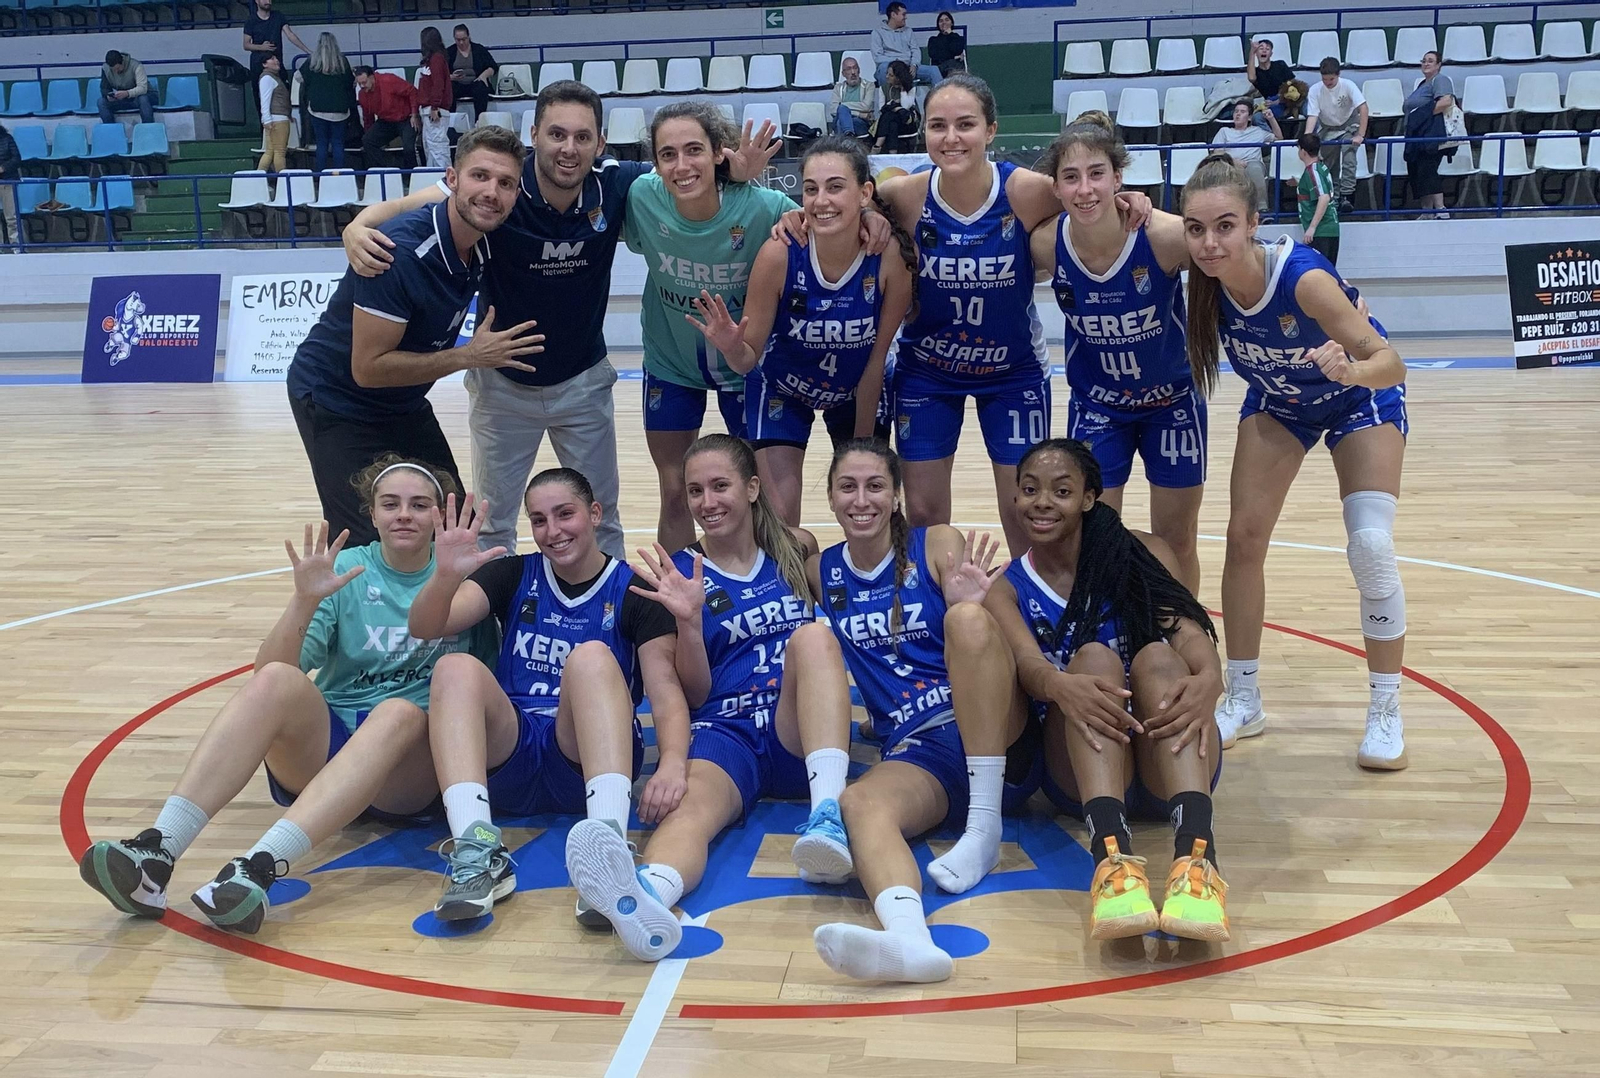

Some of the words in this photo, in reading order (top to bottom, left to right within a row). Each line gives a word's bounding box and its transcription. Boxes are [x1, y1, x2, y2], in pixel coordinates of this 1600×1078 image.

[529, 259, 589, 270] MundoMOVIL
[542, 267, 575, 276] Network
[657, 252, 748, 283] XEREZ
[919, 253, 1016, 283] XEREZ
[1537, 259, 1600, 289] DESAFIO
[674, 278, 697, 289] CLUB
[936, 281, 961, 289] CLUB
[962, 278, 1016, 290] DEPORTIVO
[1553, 290, 1593, 306] FITBOX
[949, 295, 984, 326] 10
[1064, 304, 1162, 336] XEREZ
[1516, 312, 1549, 323] TRABAJANDO
[1549, 312, 1555, 320] EL
[141, 314, 201, 333] XEREZ
[787, 316, 877, 342] XEREZ
[1521, 324, 1543, 338] PEPE
[1544, 320, 1565, 336] RUÍZ
[1571, 320, 1588, 334] 620
[1085, 336, 1108, 345] CLUB
[1109, 326, 1163, 345] DEPORTIVO
[802, 341, 827, 350] CLUB
[919, 335, 1009, 363] DESAFIO
[1537, 340, 1570, 354] ¿ACEPTAS
[1572, 339, 1579, 348] EL
[250, 363, 284, 375] Reservas
[818, 351, 838, 378] 4
[1099, 351, 1142, 381] 44
[1252, 373, 1301, 396] 15
[1008, 409, 1044, 445] 10
[1160, 428, 1200, 466] 44
[384, 652, 410, 663] CLUB
[752, 639, 786, 674] 14
[525, 660, 549, 673] CLUB
